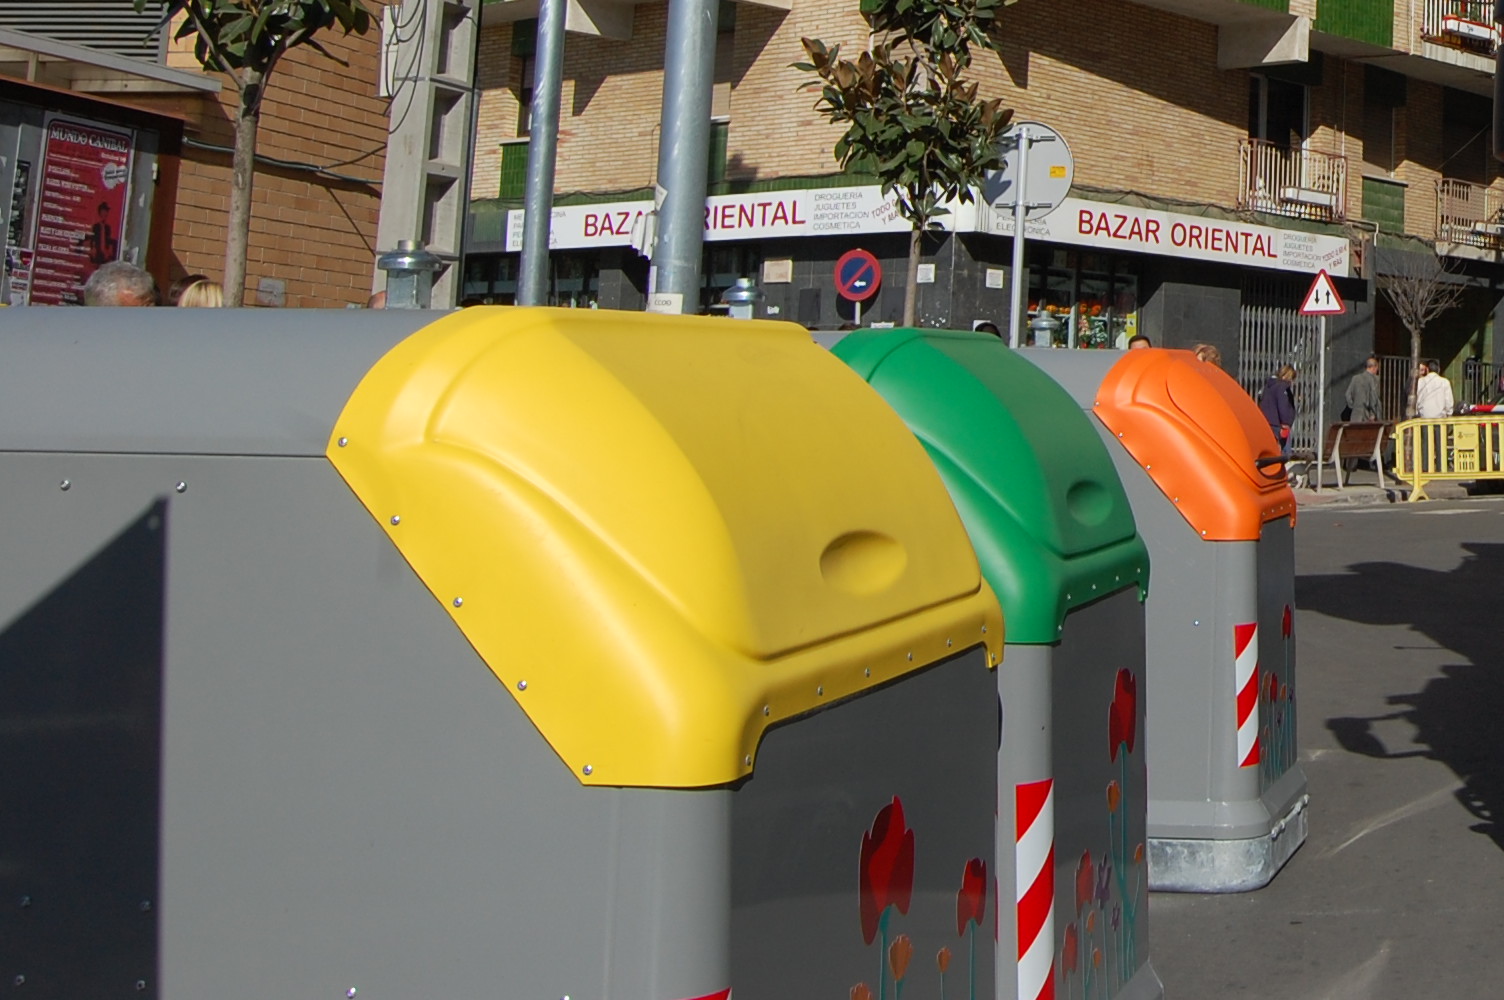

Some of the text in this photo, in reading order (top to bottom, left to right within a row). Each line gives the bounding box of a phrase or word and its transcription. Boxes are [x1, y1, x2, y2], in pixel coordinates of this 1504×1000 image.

[814, 202, 857, 212] JUGUETES
[1077, 209, 1278, 260] BAZAR ORIENTAL
